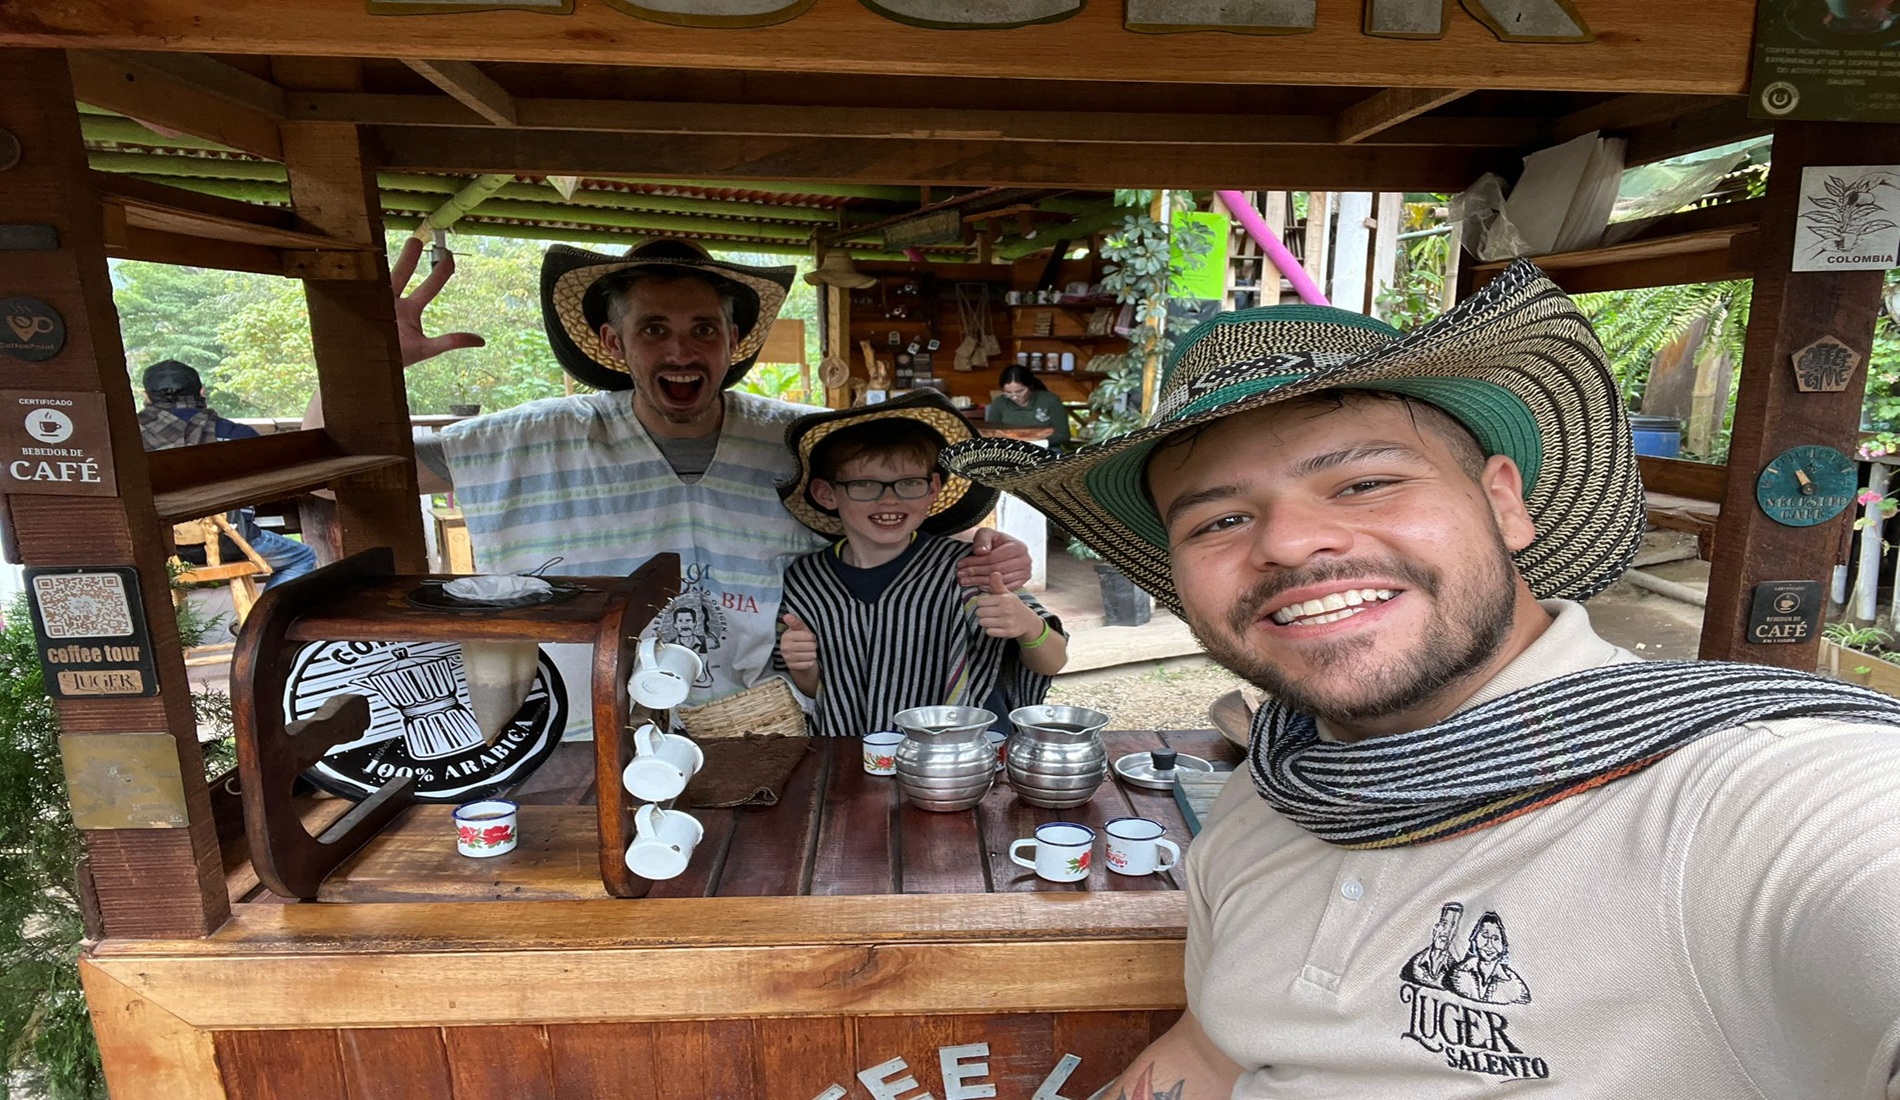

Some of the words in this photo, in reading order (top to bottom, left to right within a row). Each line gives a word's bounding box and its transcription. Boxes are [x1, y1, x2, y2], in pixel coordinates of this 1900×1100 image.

[1827, 254, 1894, 265] COLOMBIA
[19, 398, 73, 406] CERTIFICADO
[22, 447, 68, 456] BEBEDOR
[70, 449, 84, 457] DE
[10, 457, 101, 482] CAFÉ
[1755, 621, 1808, 638] CAFÉ
[46, 645, 103, 664] coffee
[104, 645, 140, 662] tour
[361, 759, 435, 782] 100%
[445, 721, 534, 780] ARABICA
[1400, 984, 1524, 1054] LUGER
[1445, 1047, 1550, 1078] SALENTO
